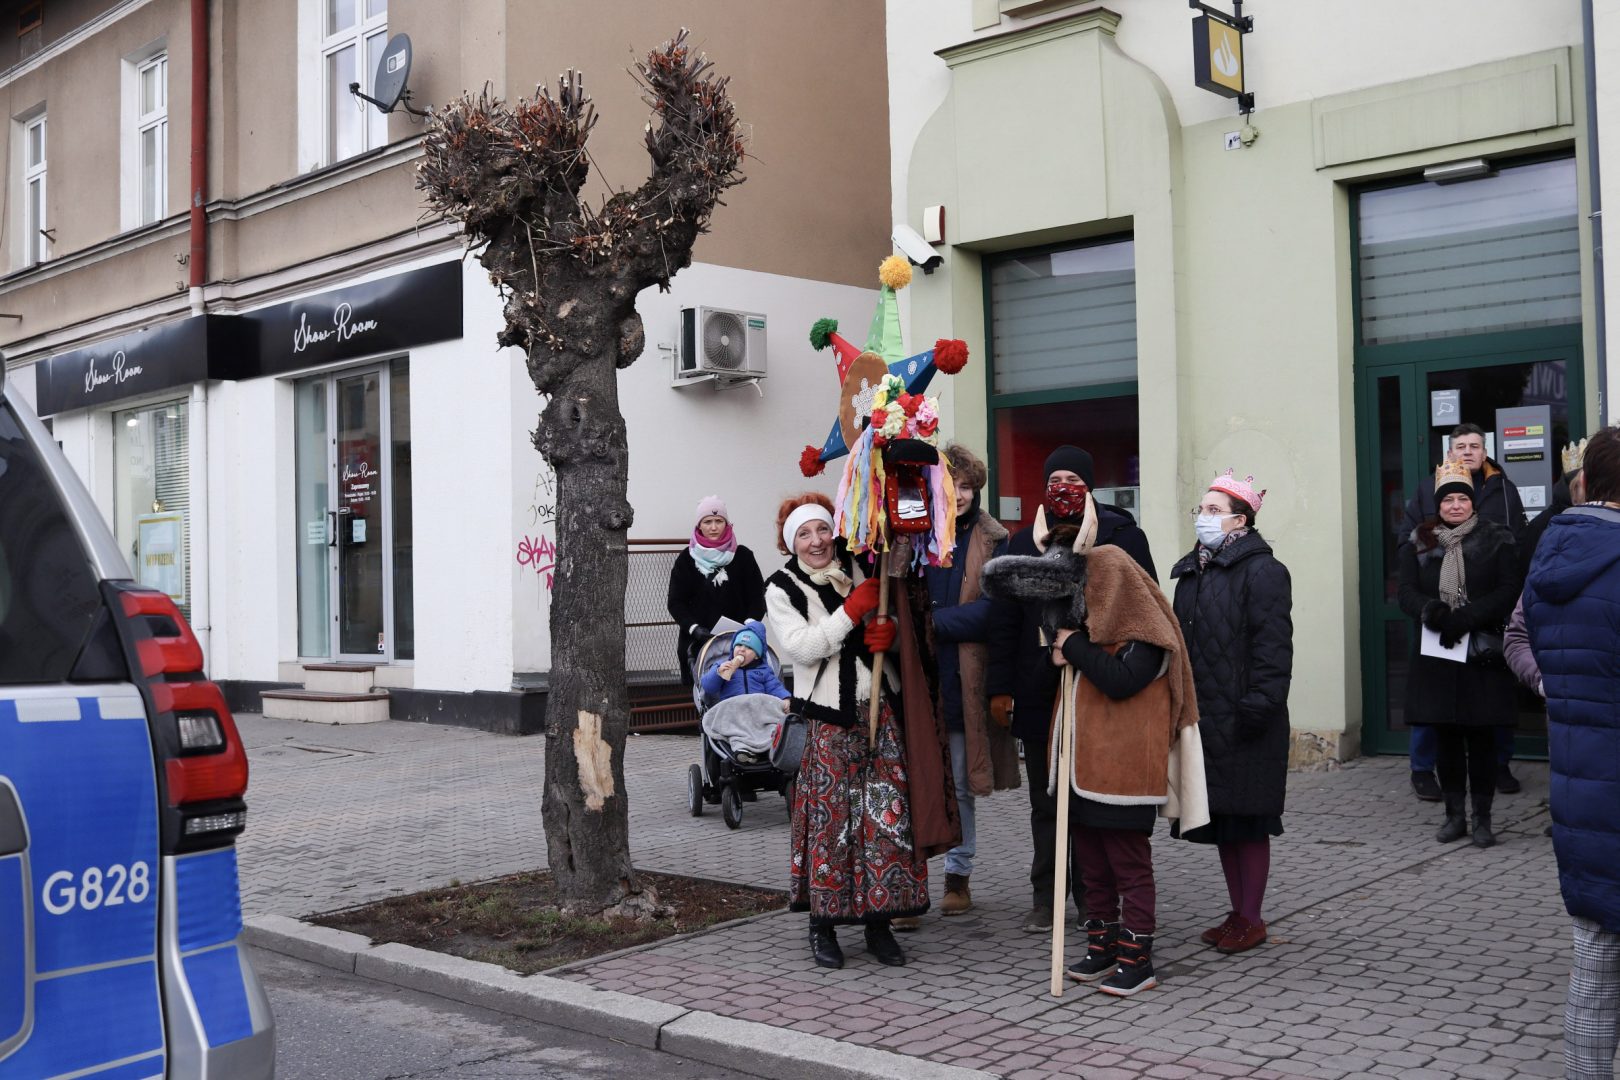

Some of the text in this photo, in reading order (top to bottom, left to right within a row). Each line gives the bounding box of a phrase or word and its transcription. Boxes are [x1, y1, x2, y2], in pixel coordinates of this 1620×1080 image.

[293, 302, 378, 354] Show-Room
[85, 350, 143, 394] Show-Room
[42, 860, 150, 916] G828
